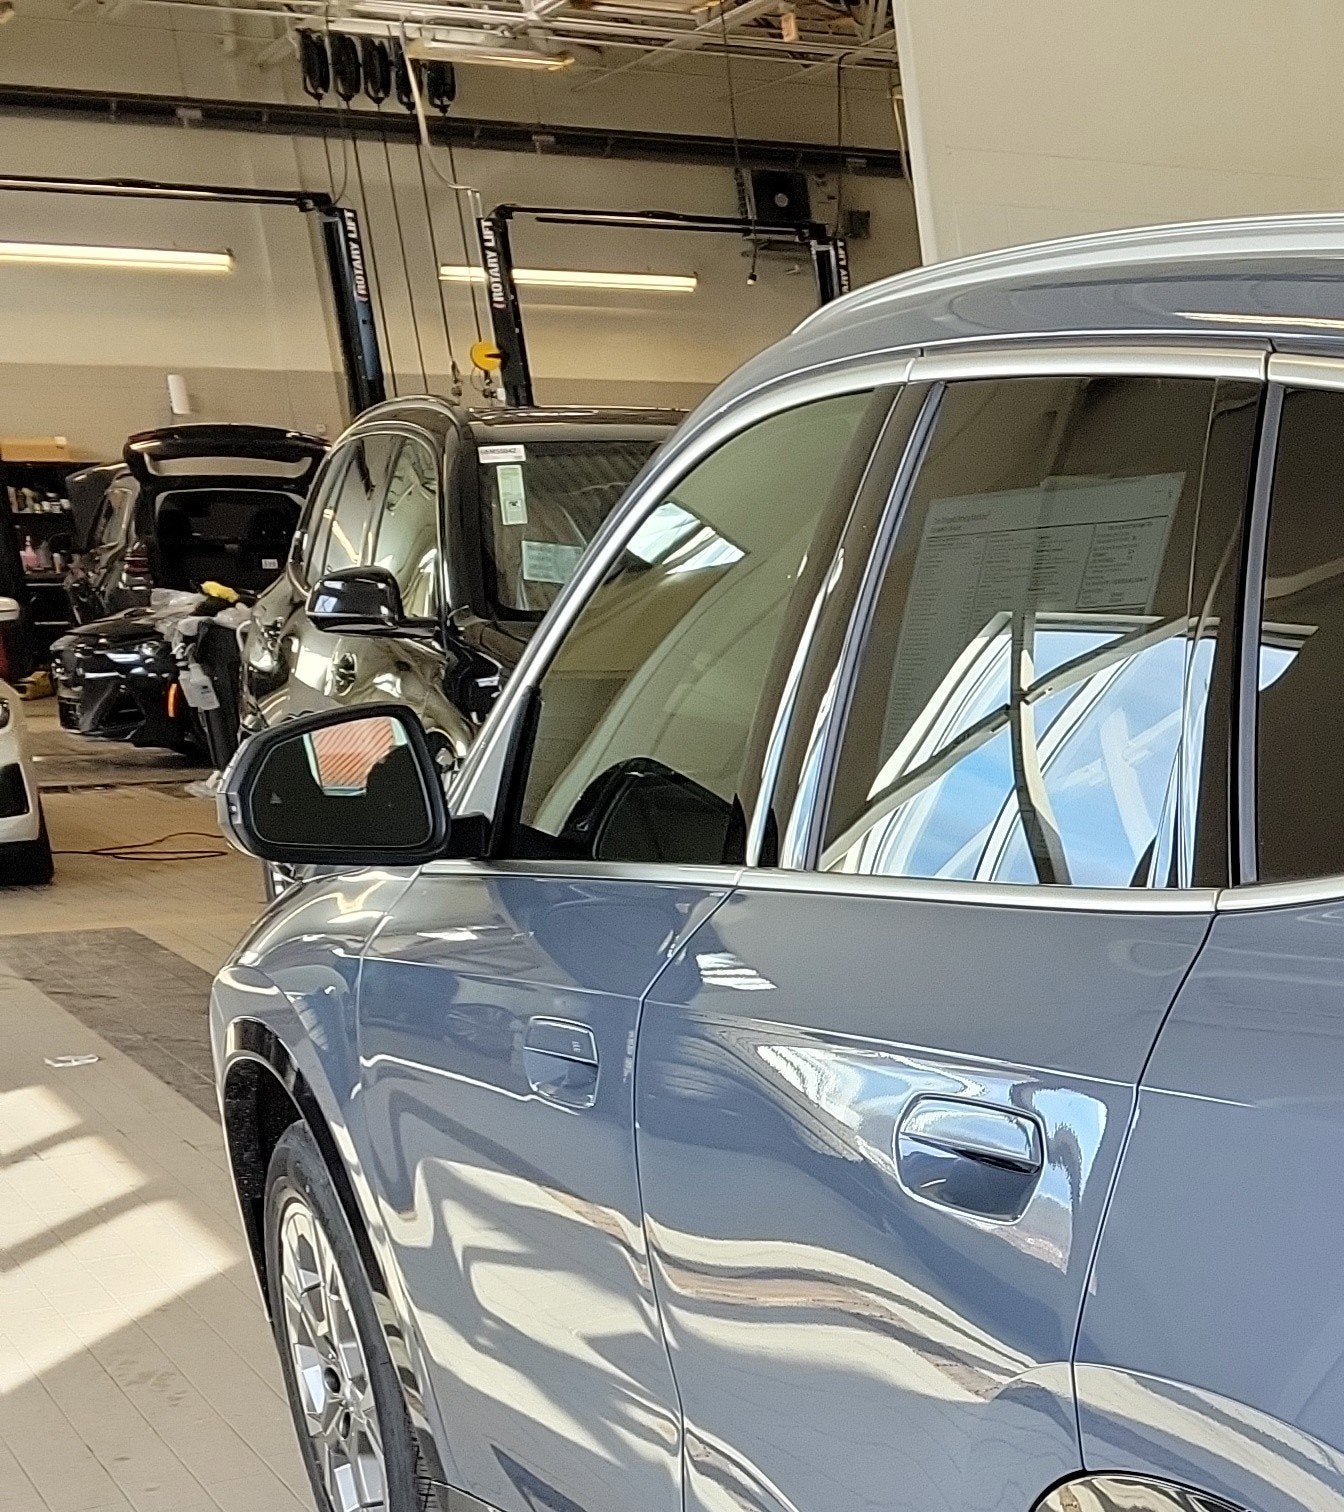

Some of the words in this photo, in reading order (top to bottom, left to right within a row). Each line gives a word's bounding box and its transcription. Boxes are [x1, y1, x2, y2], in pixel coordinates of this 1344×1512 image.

[343, 209, 357, 239] LIFT
[481, 221, 495, 247] LIFT
[349, 241, 367, 295] ROTARY
[486, 251, 504, 302] ROTARY
[839, 269, 849, 292] ARY
